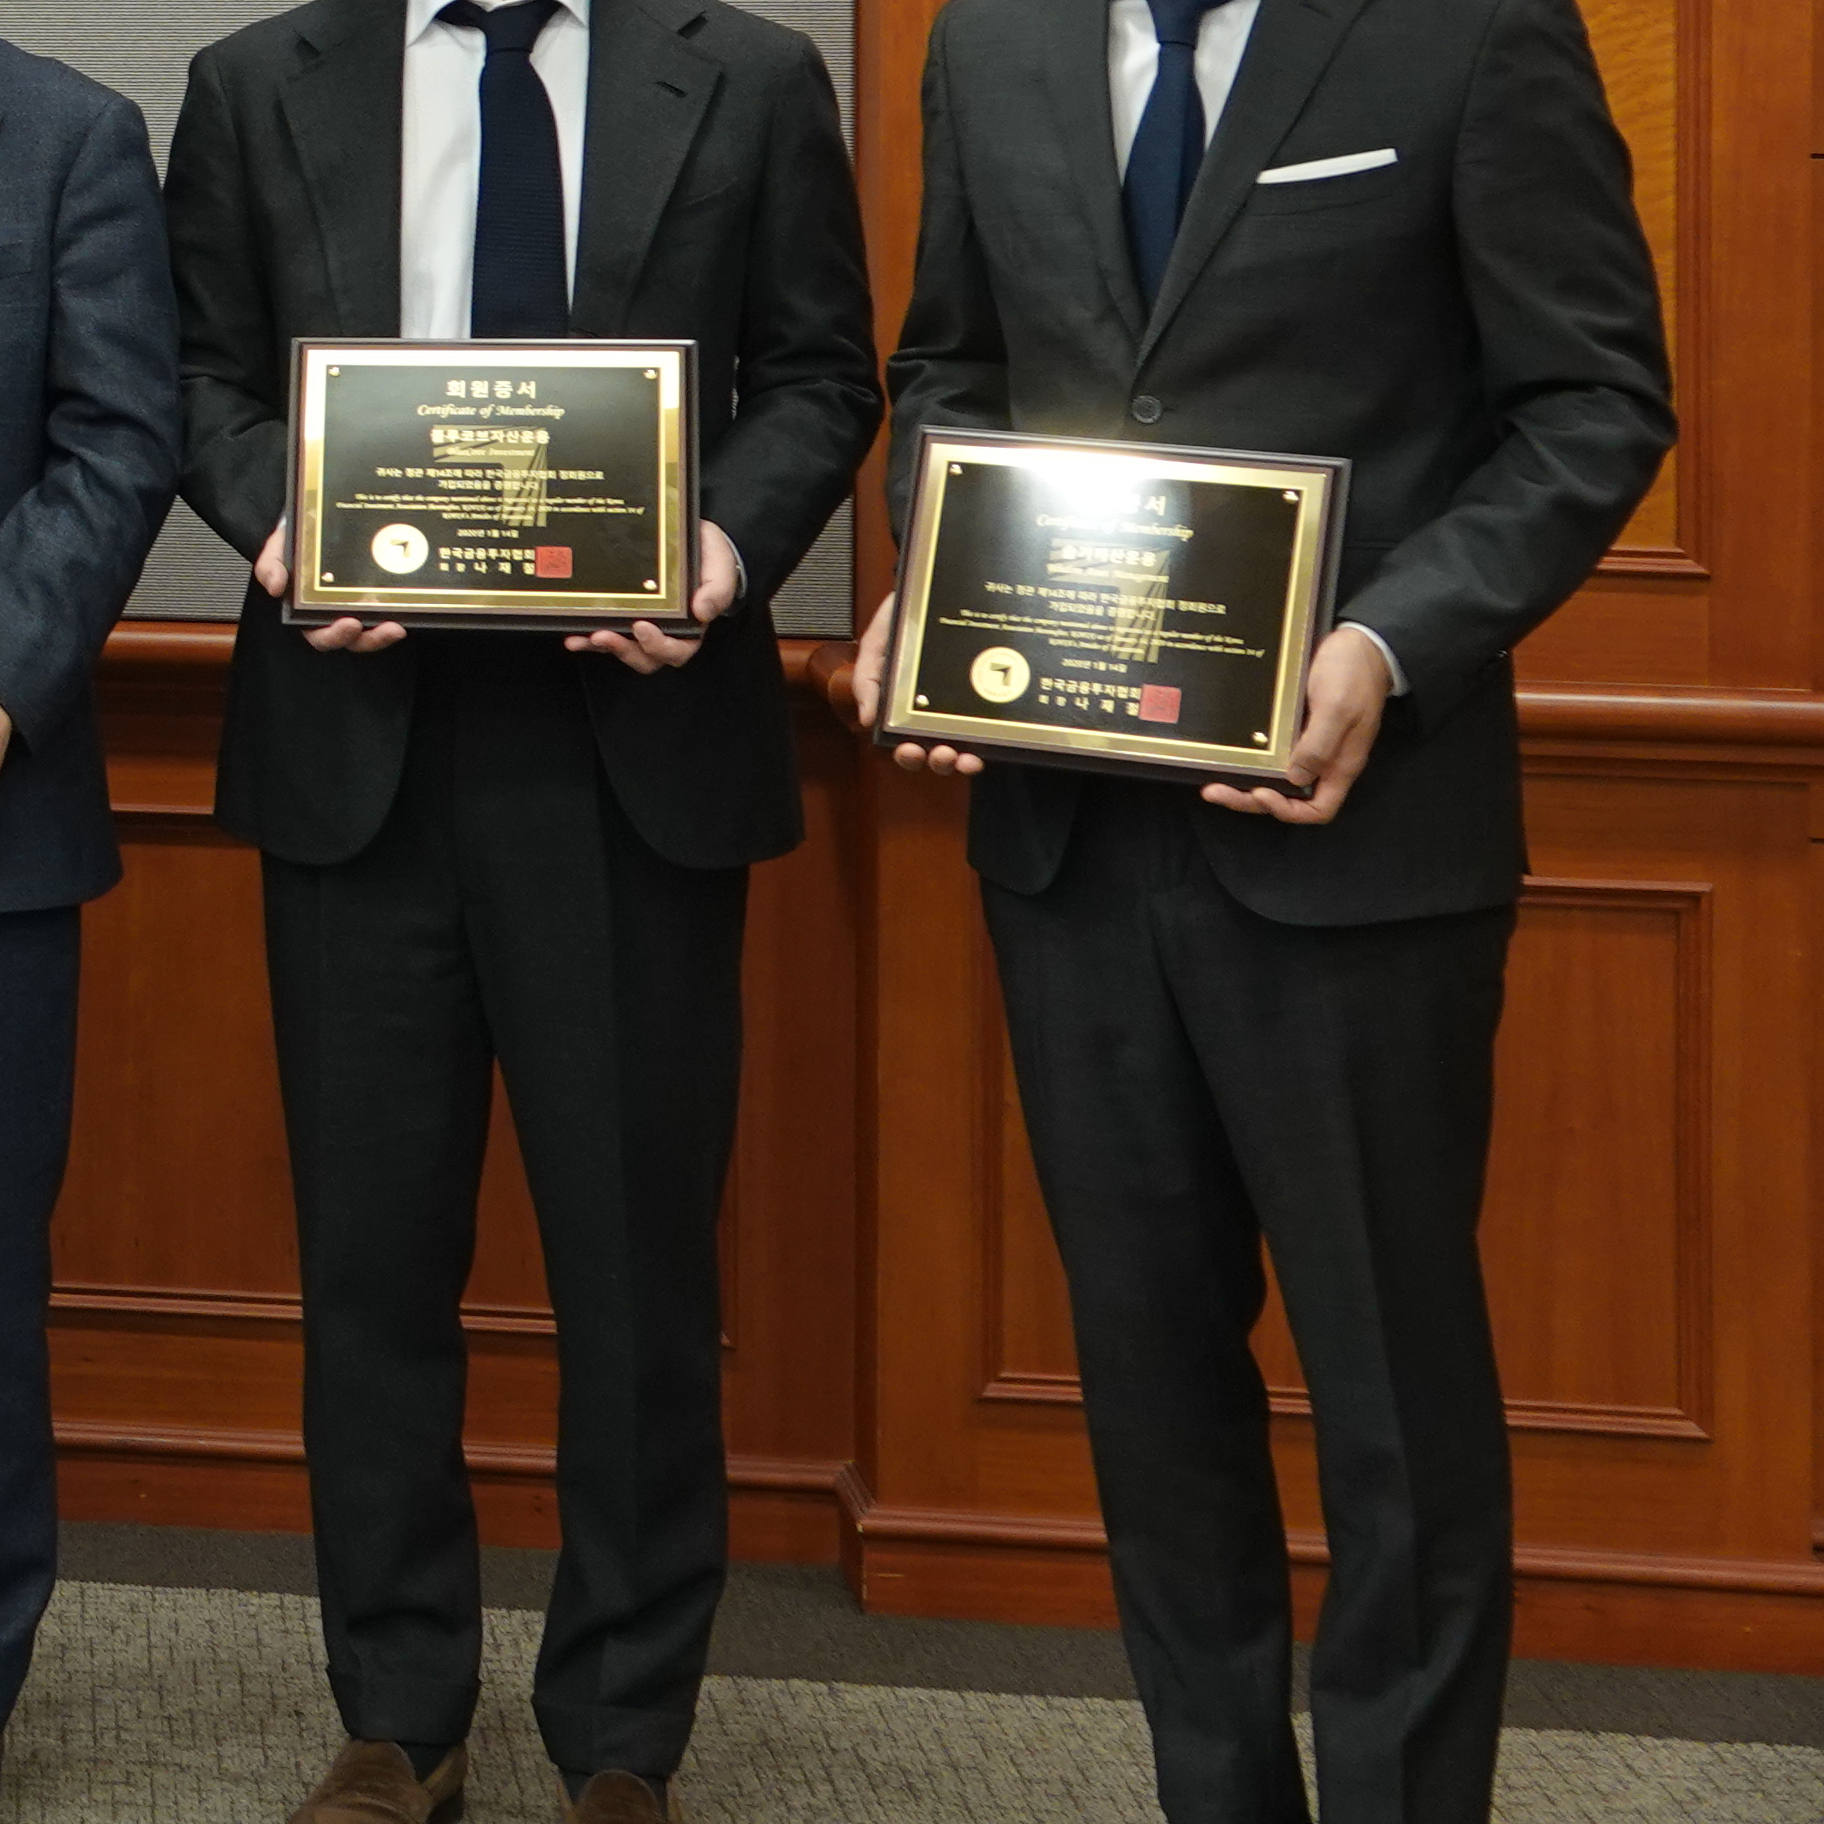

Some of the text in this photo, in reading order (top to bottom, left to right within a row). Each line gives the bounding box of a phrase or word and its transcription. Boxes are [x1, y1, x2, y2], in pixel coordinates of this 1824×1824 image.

[445, 378, 536, 400] 회원증서
[416, 402, 565, 420] Certificate of Membership
